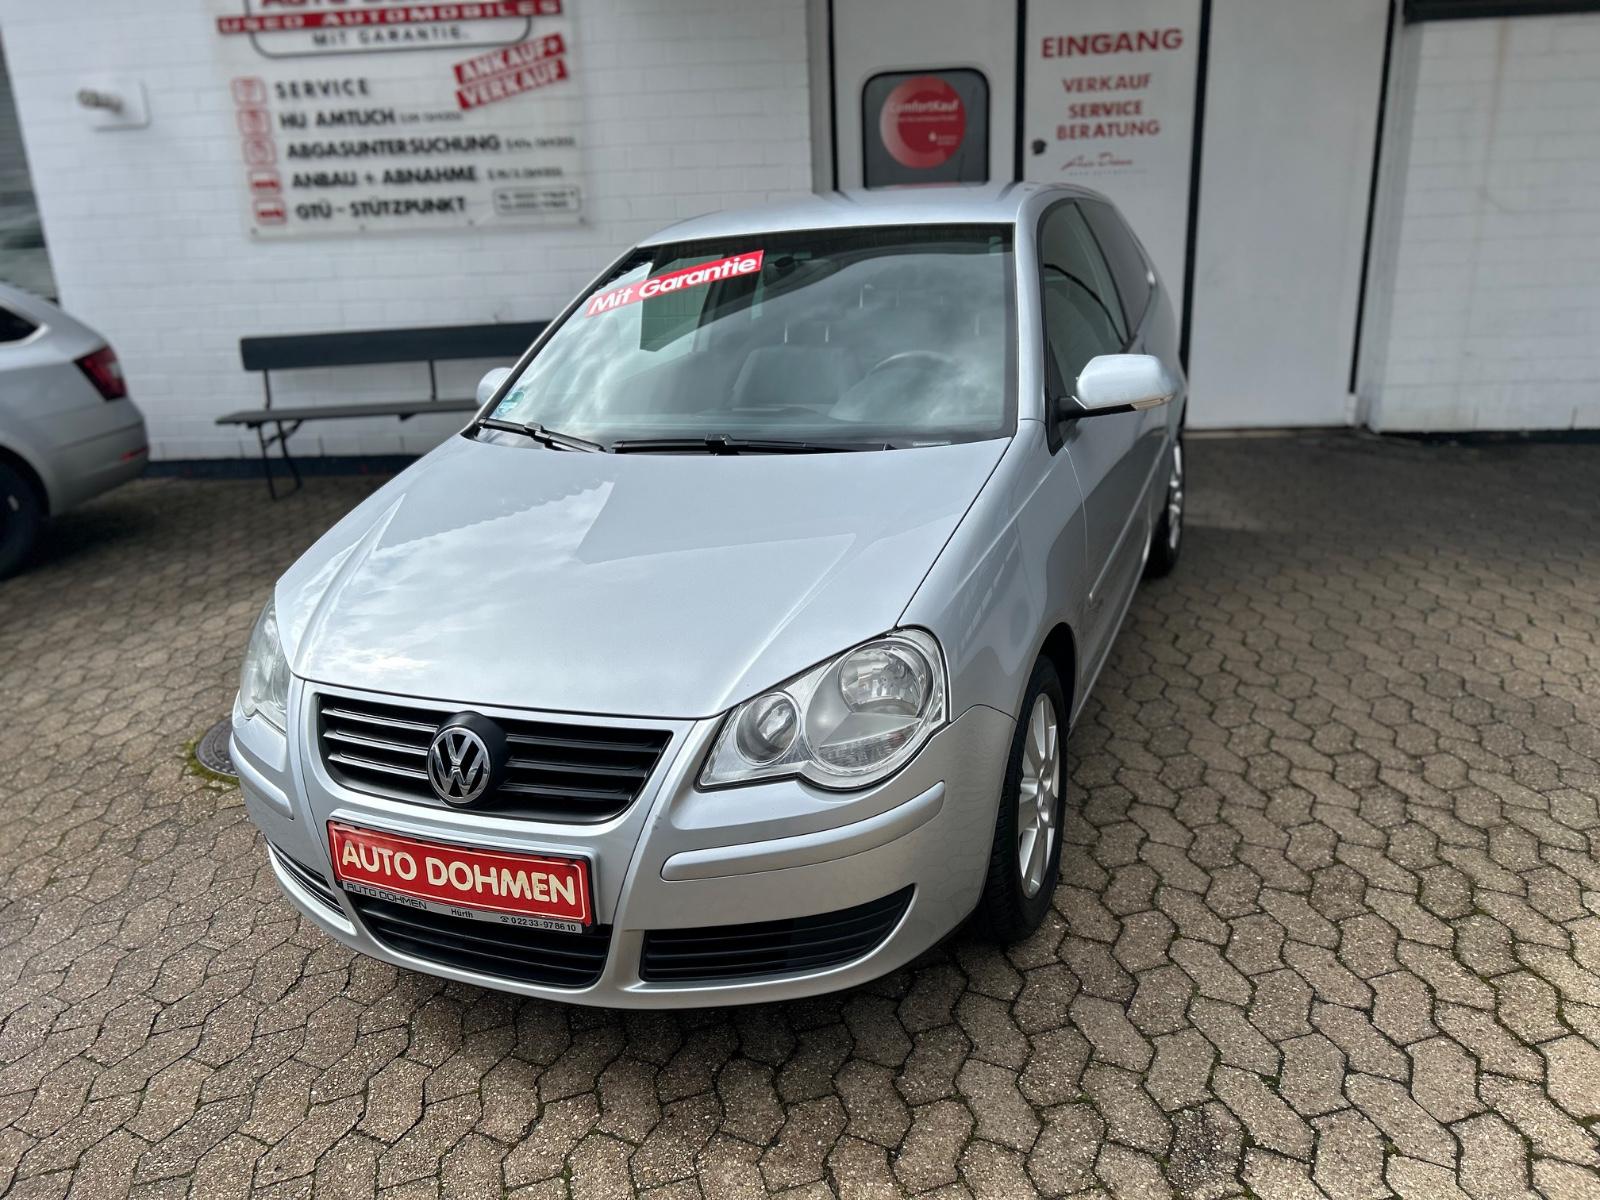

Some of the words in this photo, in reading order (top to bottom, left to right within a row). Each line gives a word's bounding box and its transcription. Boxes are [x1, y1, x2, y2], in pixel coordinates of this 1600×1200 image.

[220, 16, 304, 32] USED
[321, 1, 560, 27] AUTOMOBILES
[313, 31, 347, 45] MIT
[1041, 28, 1184, 59] EINGANG
[275, 78, 369, 99] SERVICE
[463, 61, 558, 104] VERKAUF
[1062, 73, 1152, 93] VERKAUF
[279, 112, 307, 128] HU
[316, 108, 396, 126] AMTLICH
[1068, 100, 1144, 119] SERVICE
[1056, 119, 1160, 140] BERATUNG
[287, 135, 500, 159] ABGASUNTERSUCHUNG
[293, 170, 358, 188] ANBAU
[383, 166, 477, 184] ABNAHME
[589, 287, 633, 313] Mit
[638, 257, 757, 298] Garantie
[342, 839, 418, 881] AUTO
[425, 856, 576, 906] DOHMEN
[346, 883, 377, 897] AUTO
[379, 890, 427, 910] DOHMEN
